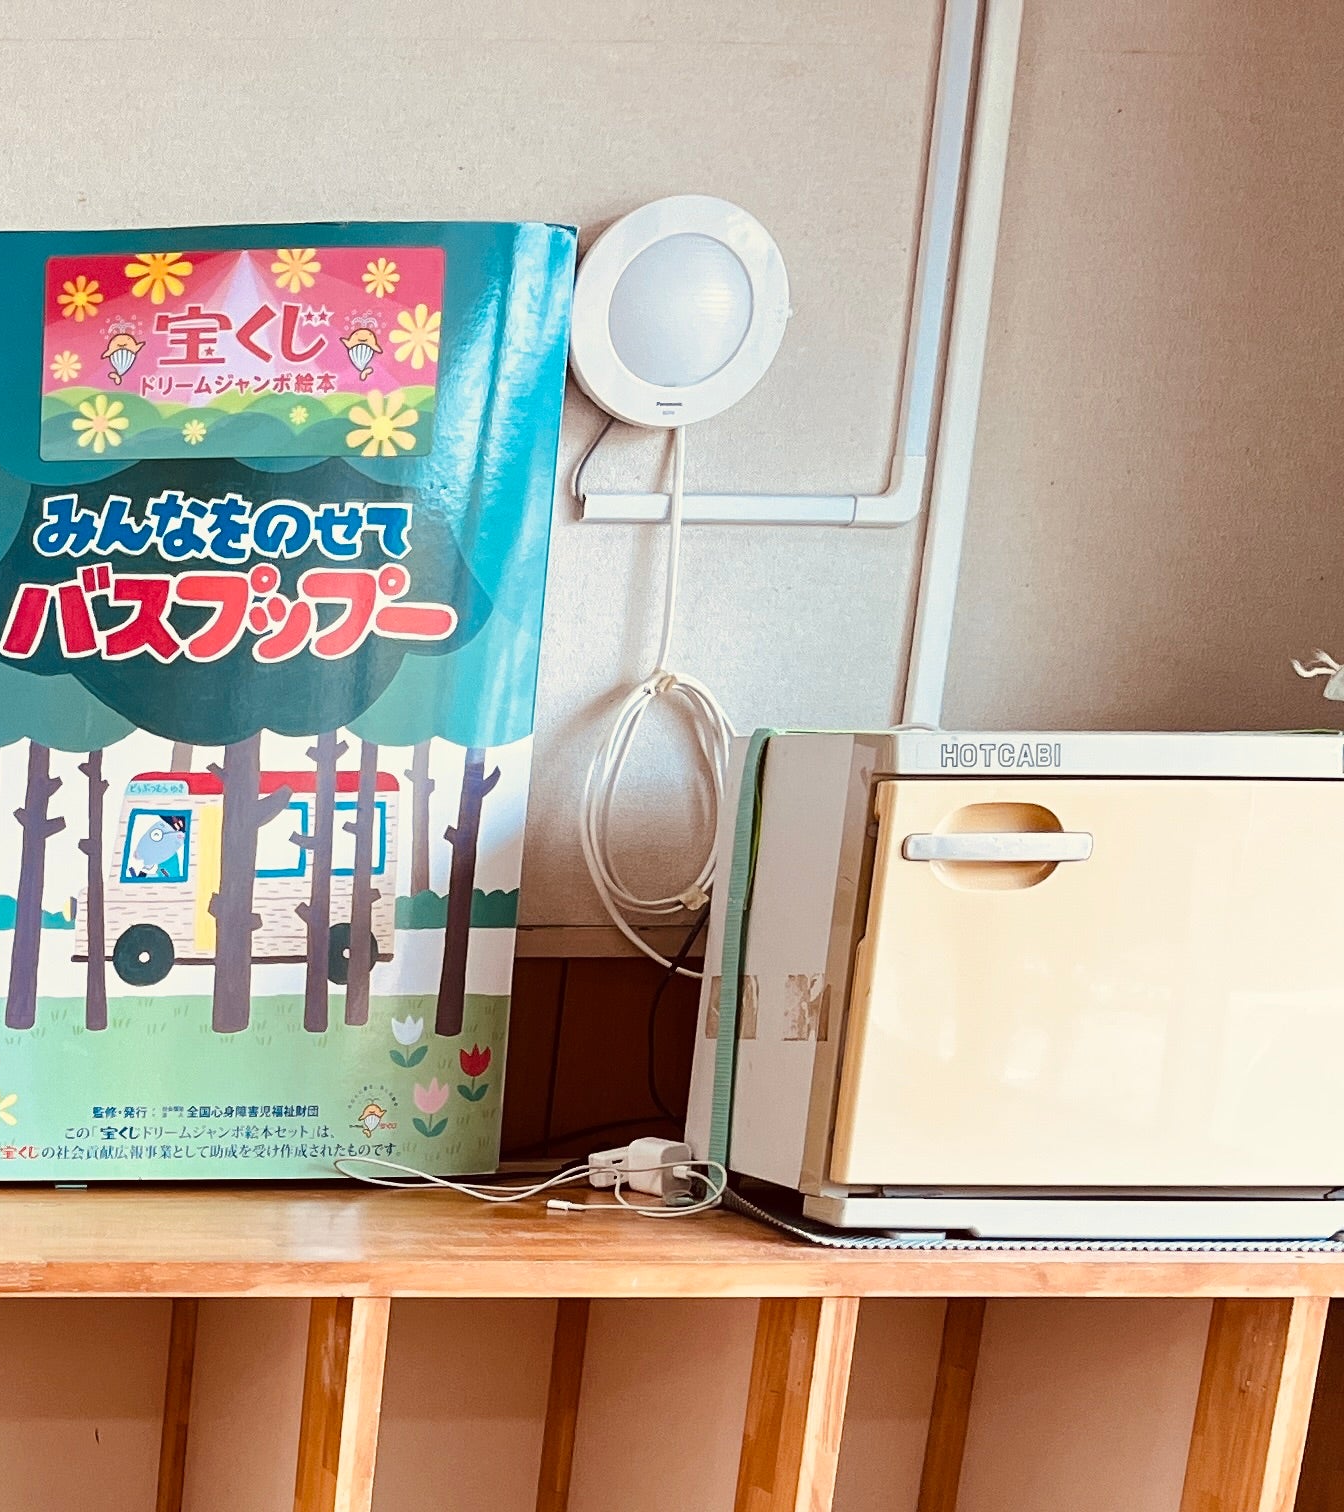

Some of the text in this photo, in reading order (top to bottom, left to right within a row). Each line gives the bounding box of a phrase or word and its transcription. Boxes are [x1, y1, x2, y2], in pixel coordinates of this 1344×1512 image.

[152, 302, 333, 368] 宝くじ
[139, 372, 337, 397] ドリームジャンボ絵本
[33, 490, 413, 563] みんなをのせて
[941, 743, 1061, 767] HOTCABI
